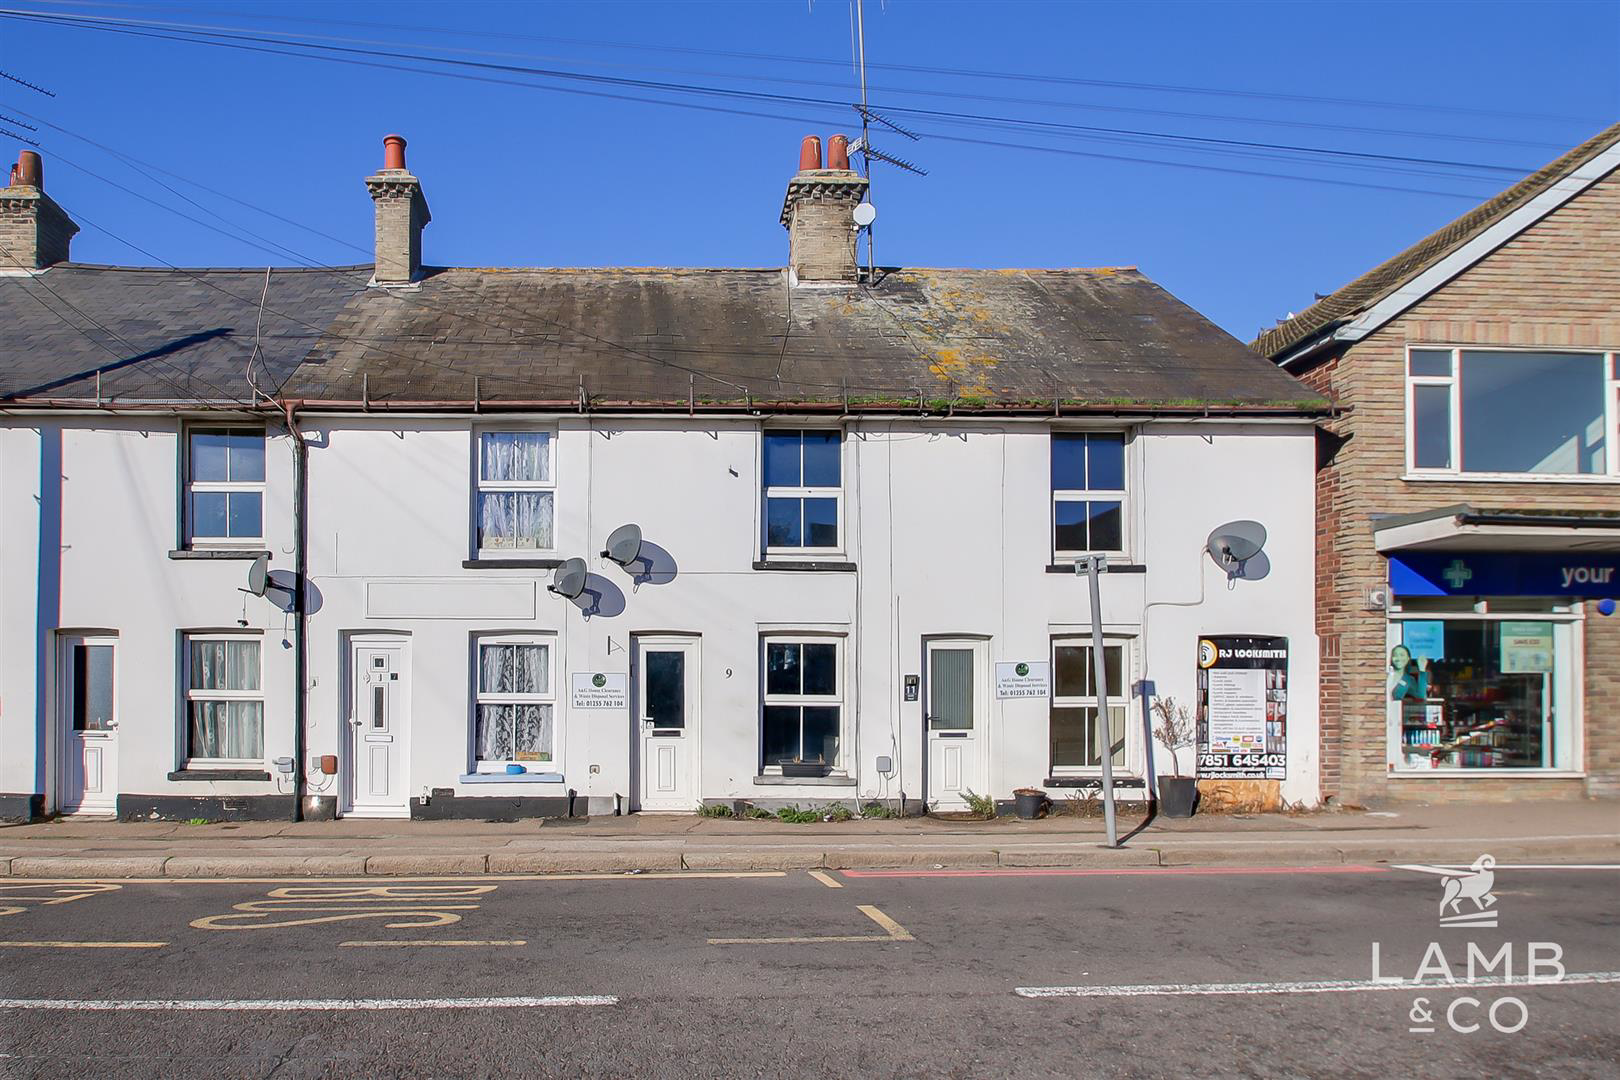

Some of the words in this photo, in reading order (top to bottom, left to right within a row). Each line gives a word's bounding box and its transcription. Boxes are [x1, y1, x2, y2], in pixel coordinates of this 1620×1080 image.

[1561, 566, 1615, 588] your
[1218, 649, 1233, 658] RJ
[1234, 649, 1287, 658] LOCKSMITH
[725, 668, 733, 679] 9
[906, 686, 916, 694] 11
[1232, 754, 1286, 766] 645403
[190, 884, 499, 931] BUS
